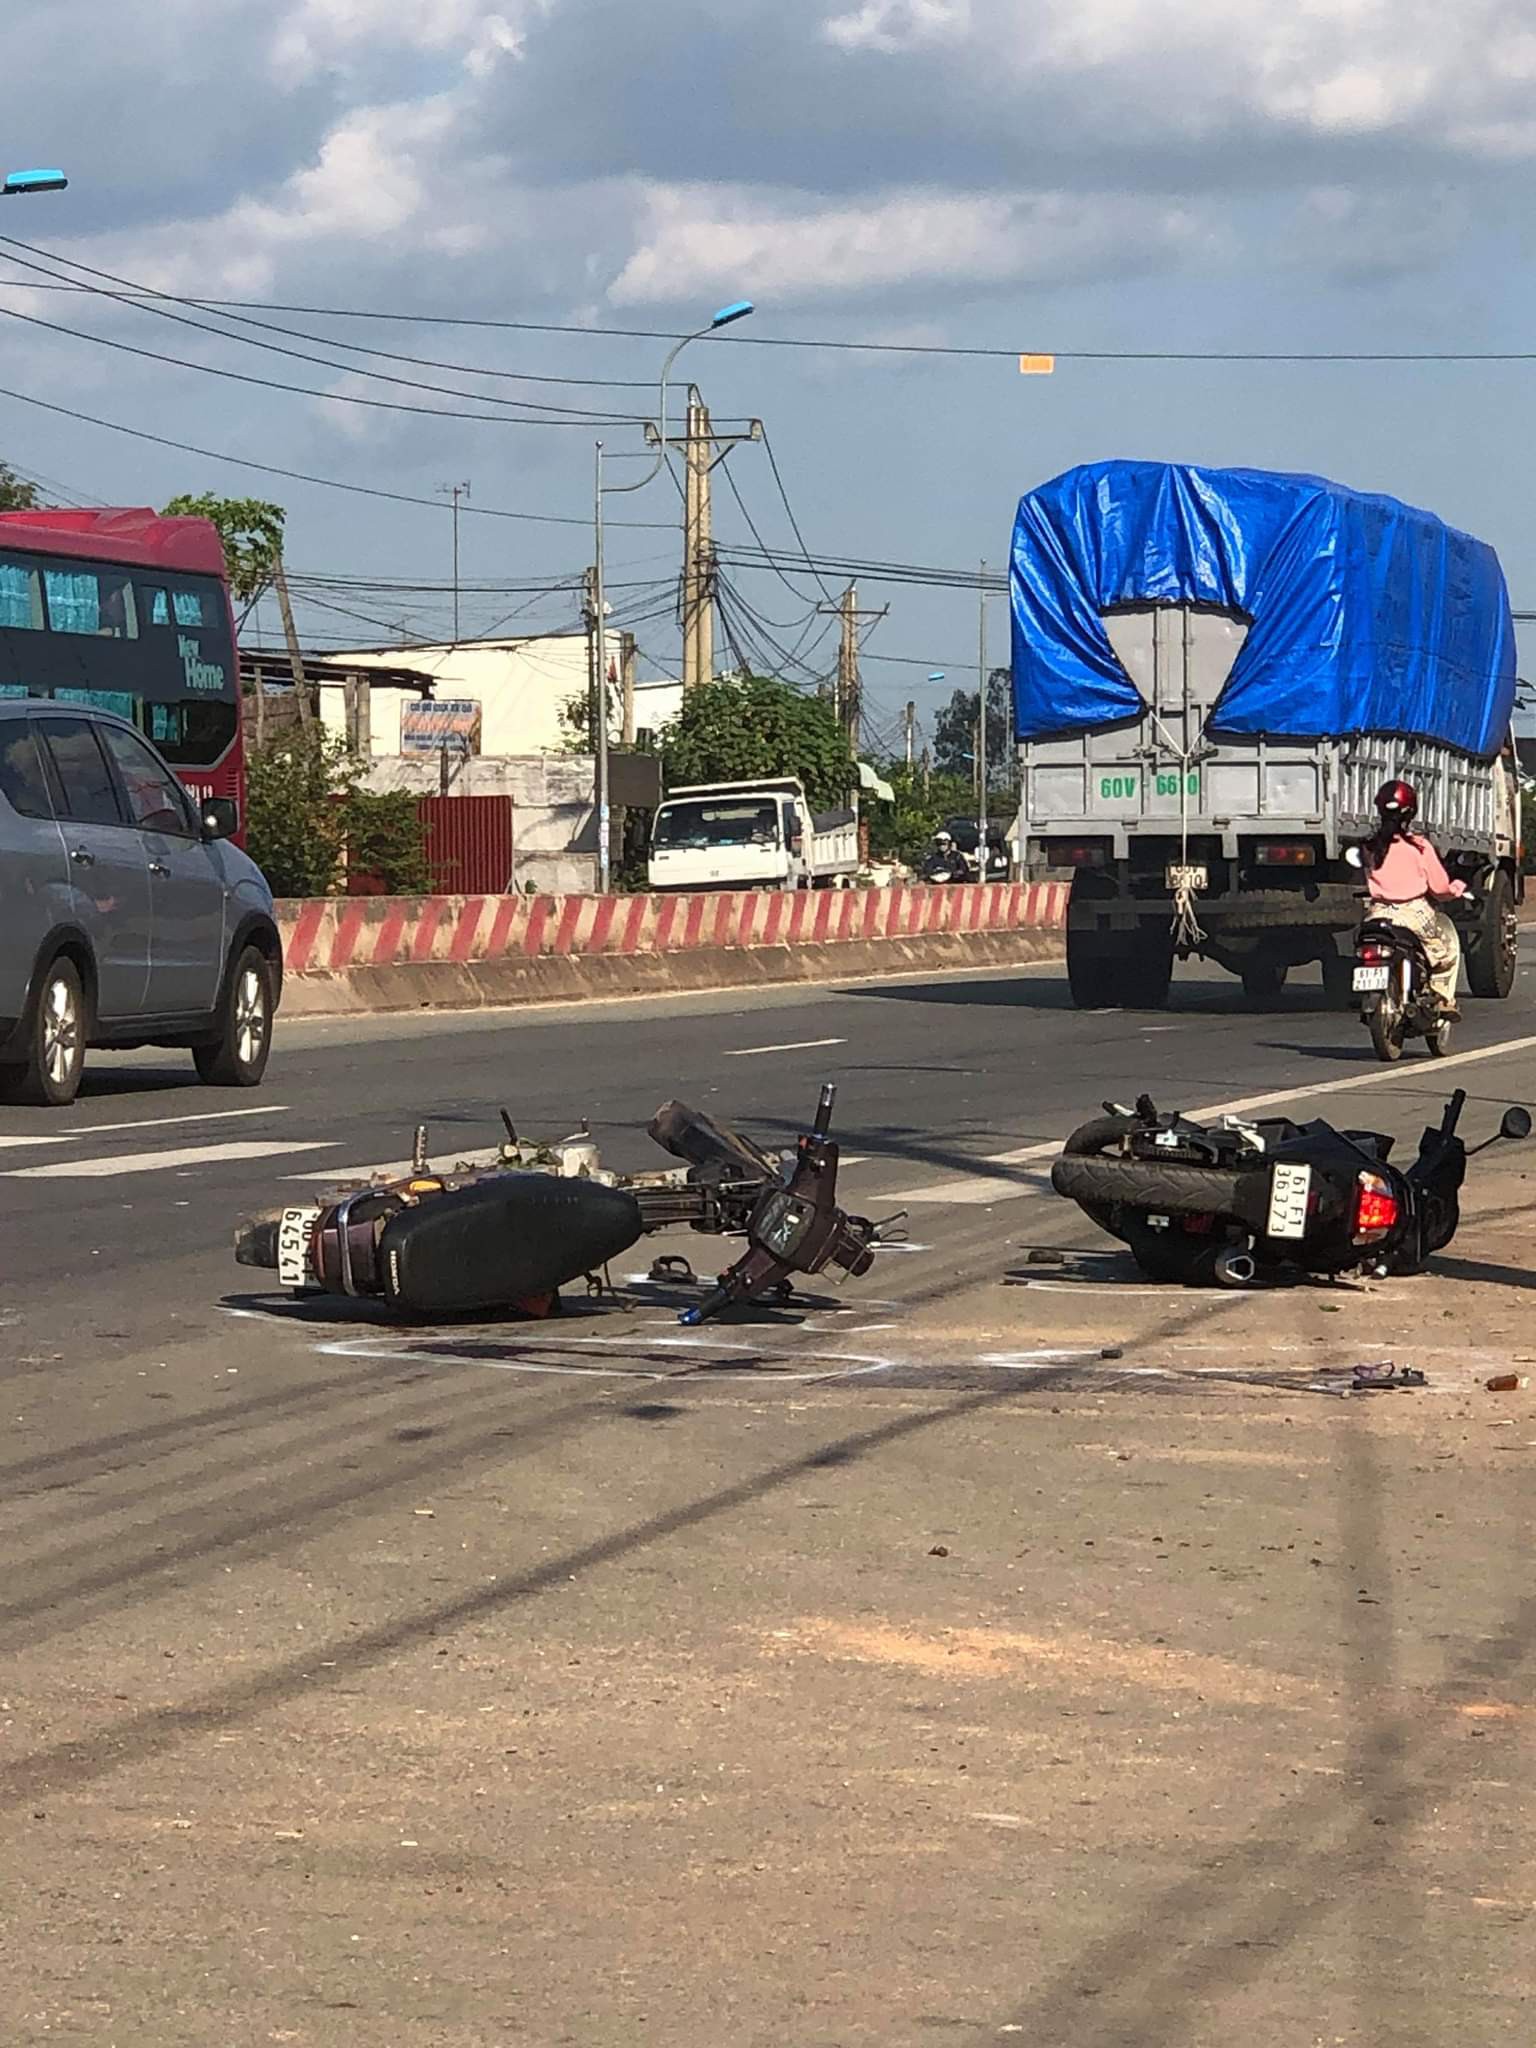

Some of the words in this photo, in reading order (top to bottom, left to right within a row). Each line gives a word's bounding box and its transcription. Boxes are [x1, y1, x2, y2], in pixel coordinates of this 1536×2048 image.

[184, 656, 224, 691] Home
[1101, 777, 1135, 798] 60V
[1156, 774, 1198, 796] 660
